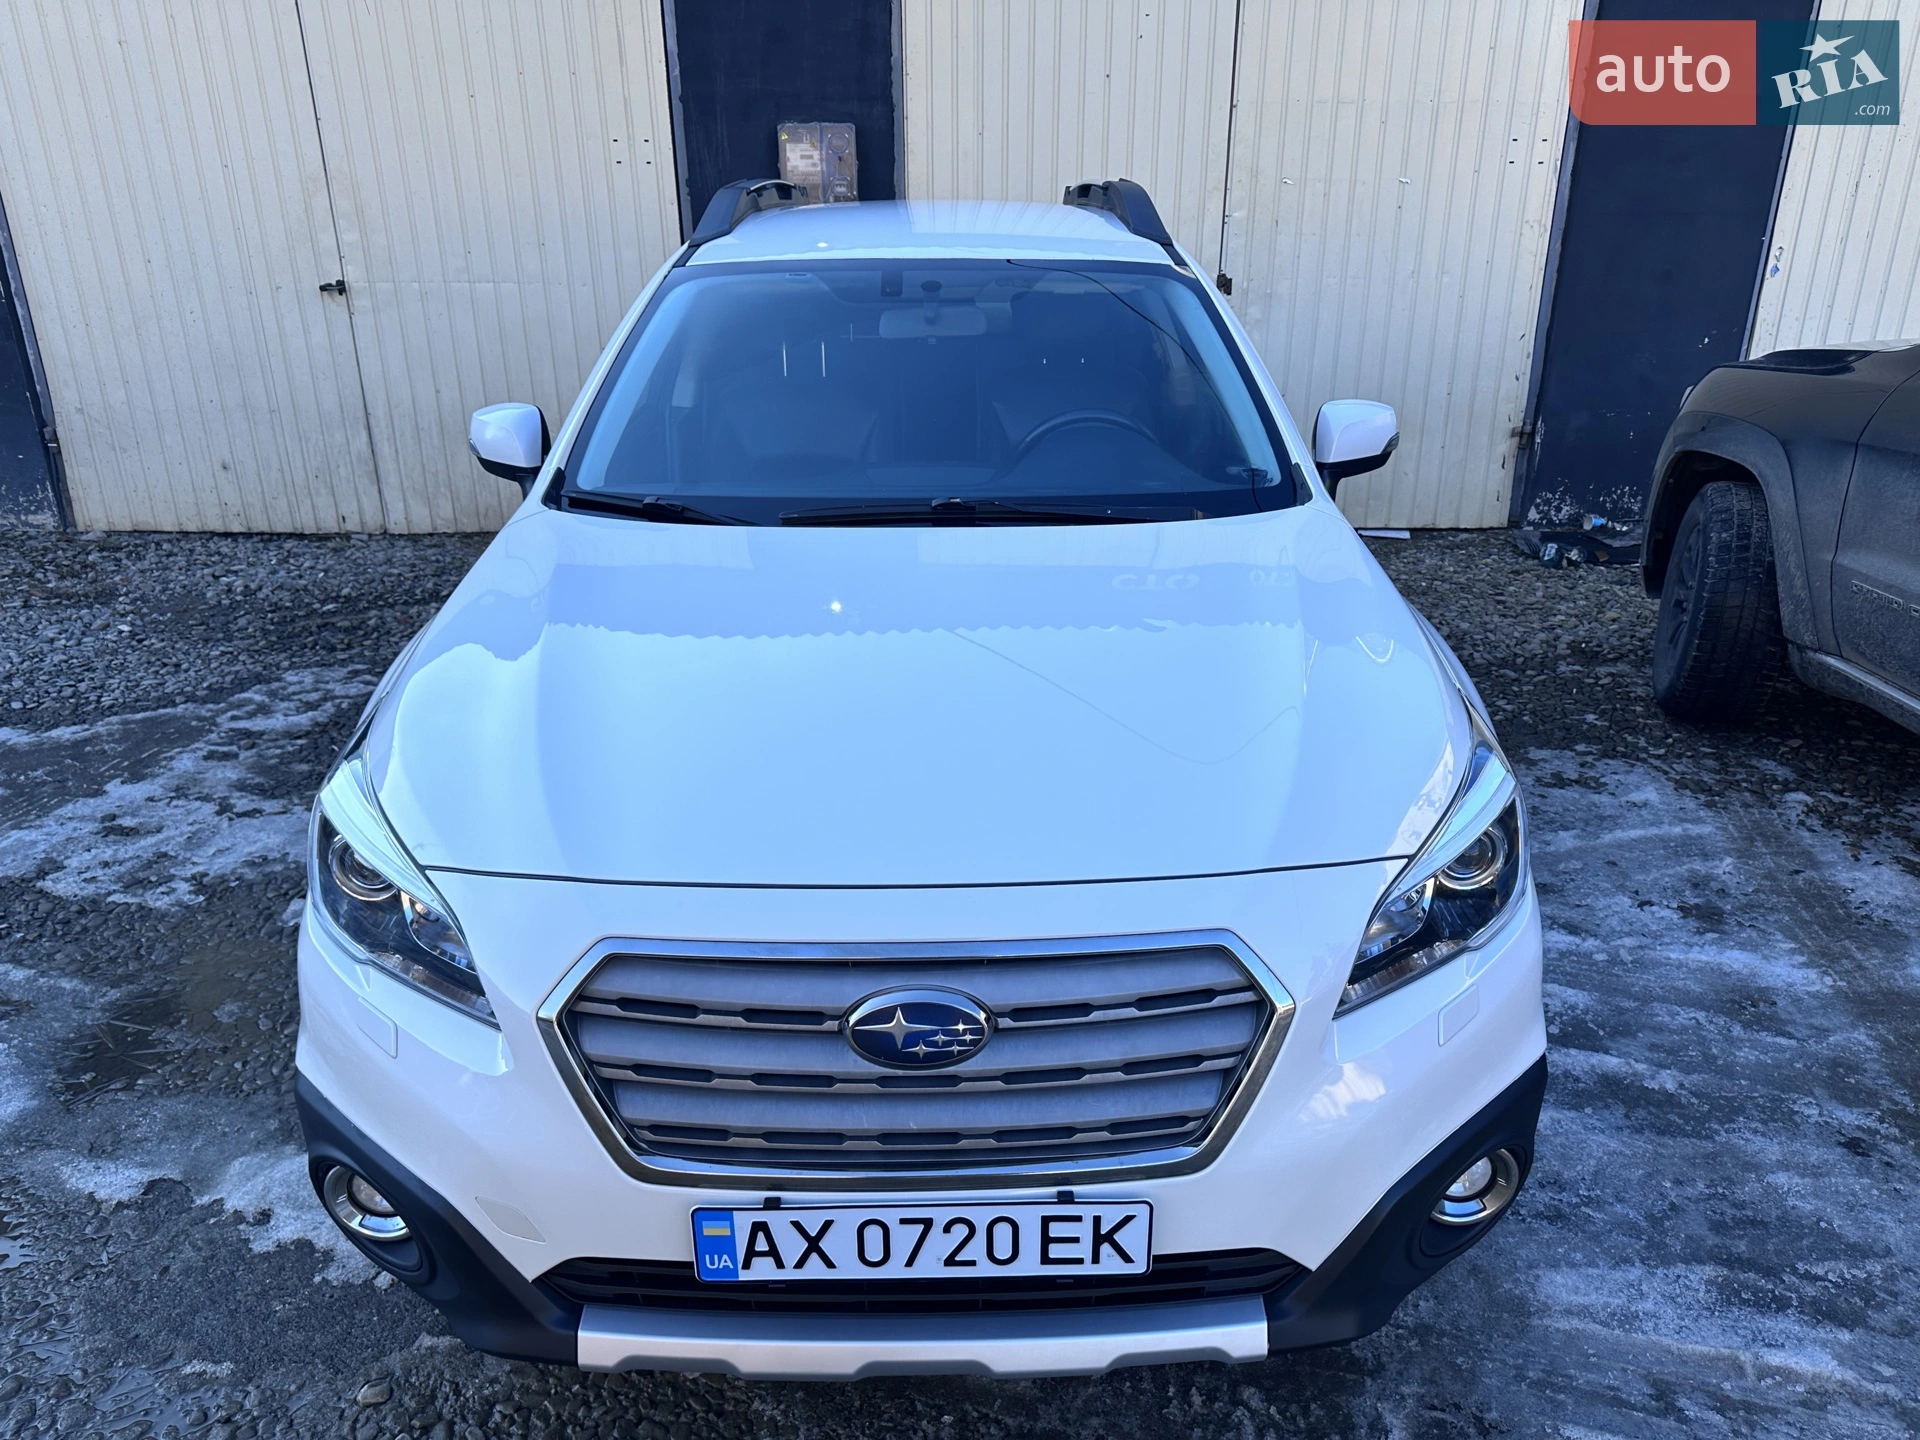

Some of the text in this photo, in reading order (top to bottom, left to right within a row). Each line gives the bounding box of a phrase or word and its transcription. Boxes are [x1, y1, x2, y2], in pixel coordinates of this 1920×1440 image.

[740, 1214, 1138, 1271] AX 0720 EK
[705, 1254, 734, 1269] UA
